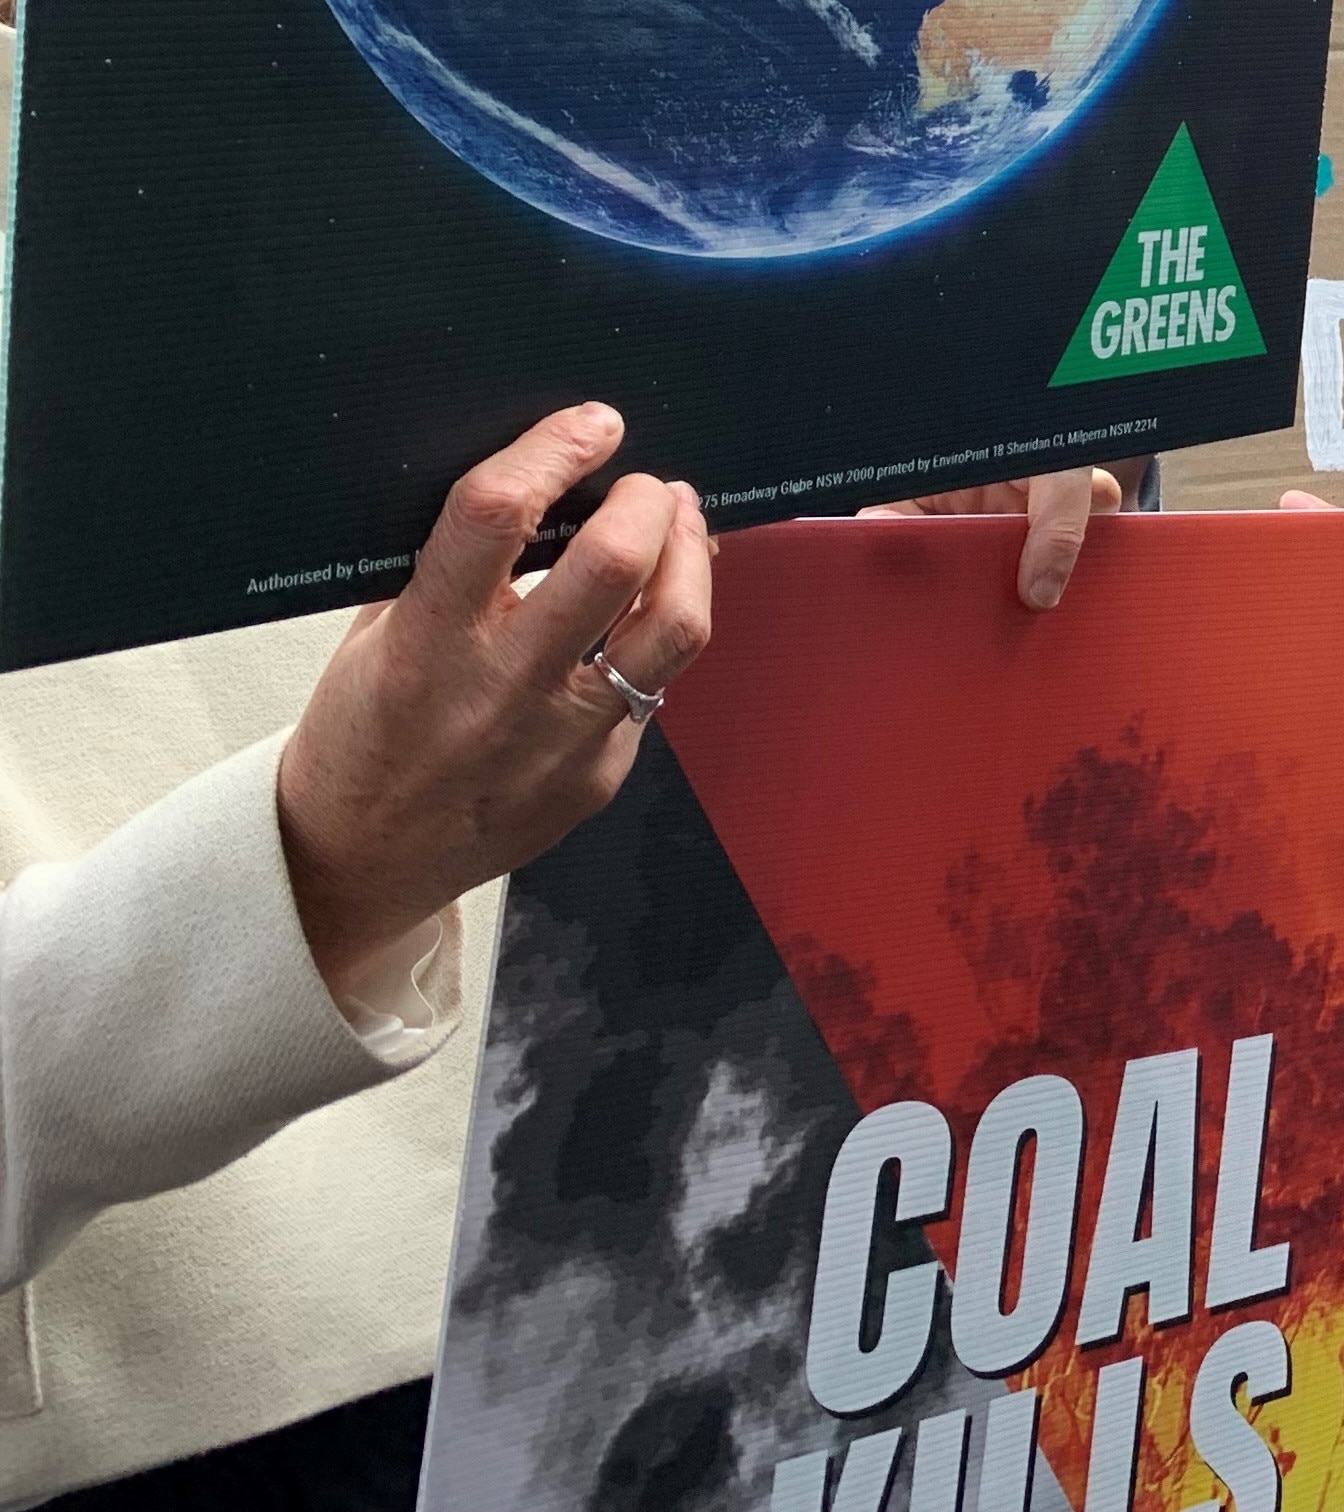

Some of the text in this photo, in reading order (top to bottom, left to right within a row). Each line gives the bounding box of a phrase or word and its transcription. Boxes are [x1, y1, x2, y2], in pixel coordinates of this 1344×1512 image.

[1137, 224, 1208, 288] THE
[1090, 284, 1237, 360] GREENS
[721, 484, 778, 507] Broadway
[780, 478, 813, 495] Glebe
[816, 471, 844, 488] NSW
[876, 457, 916, 481] printed
[917, 456, 931, 473] by
[1006, 436, 1050, 456] Sheridan
[1109, 421, 1134, 437] NSW
[1134, 416, 1158, 433] 2214
[246, 563, 332, 595] Authorised
[335, 562, 355, 580] by
[358, 552, 411, 575] Greens
[804, 1032, 1292, 1420] COAL
